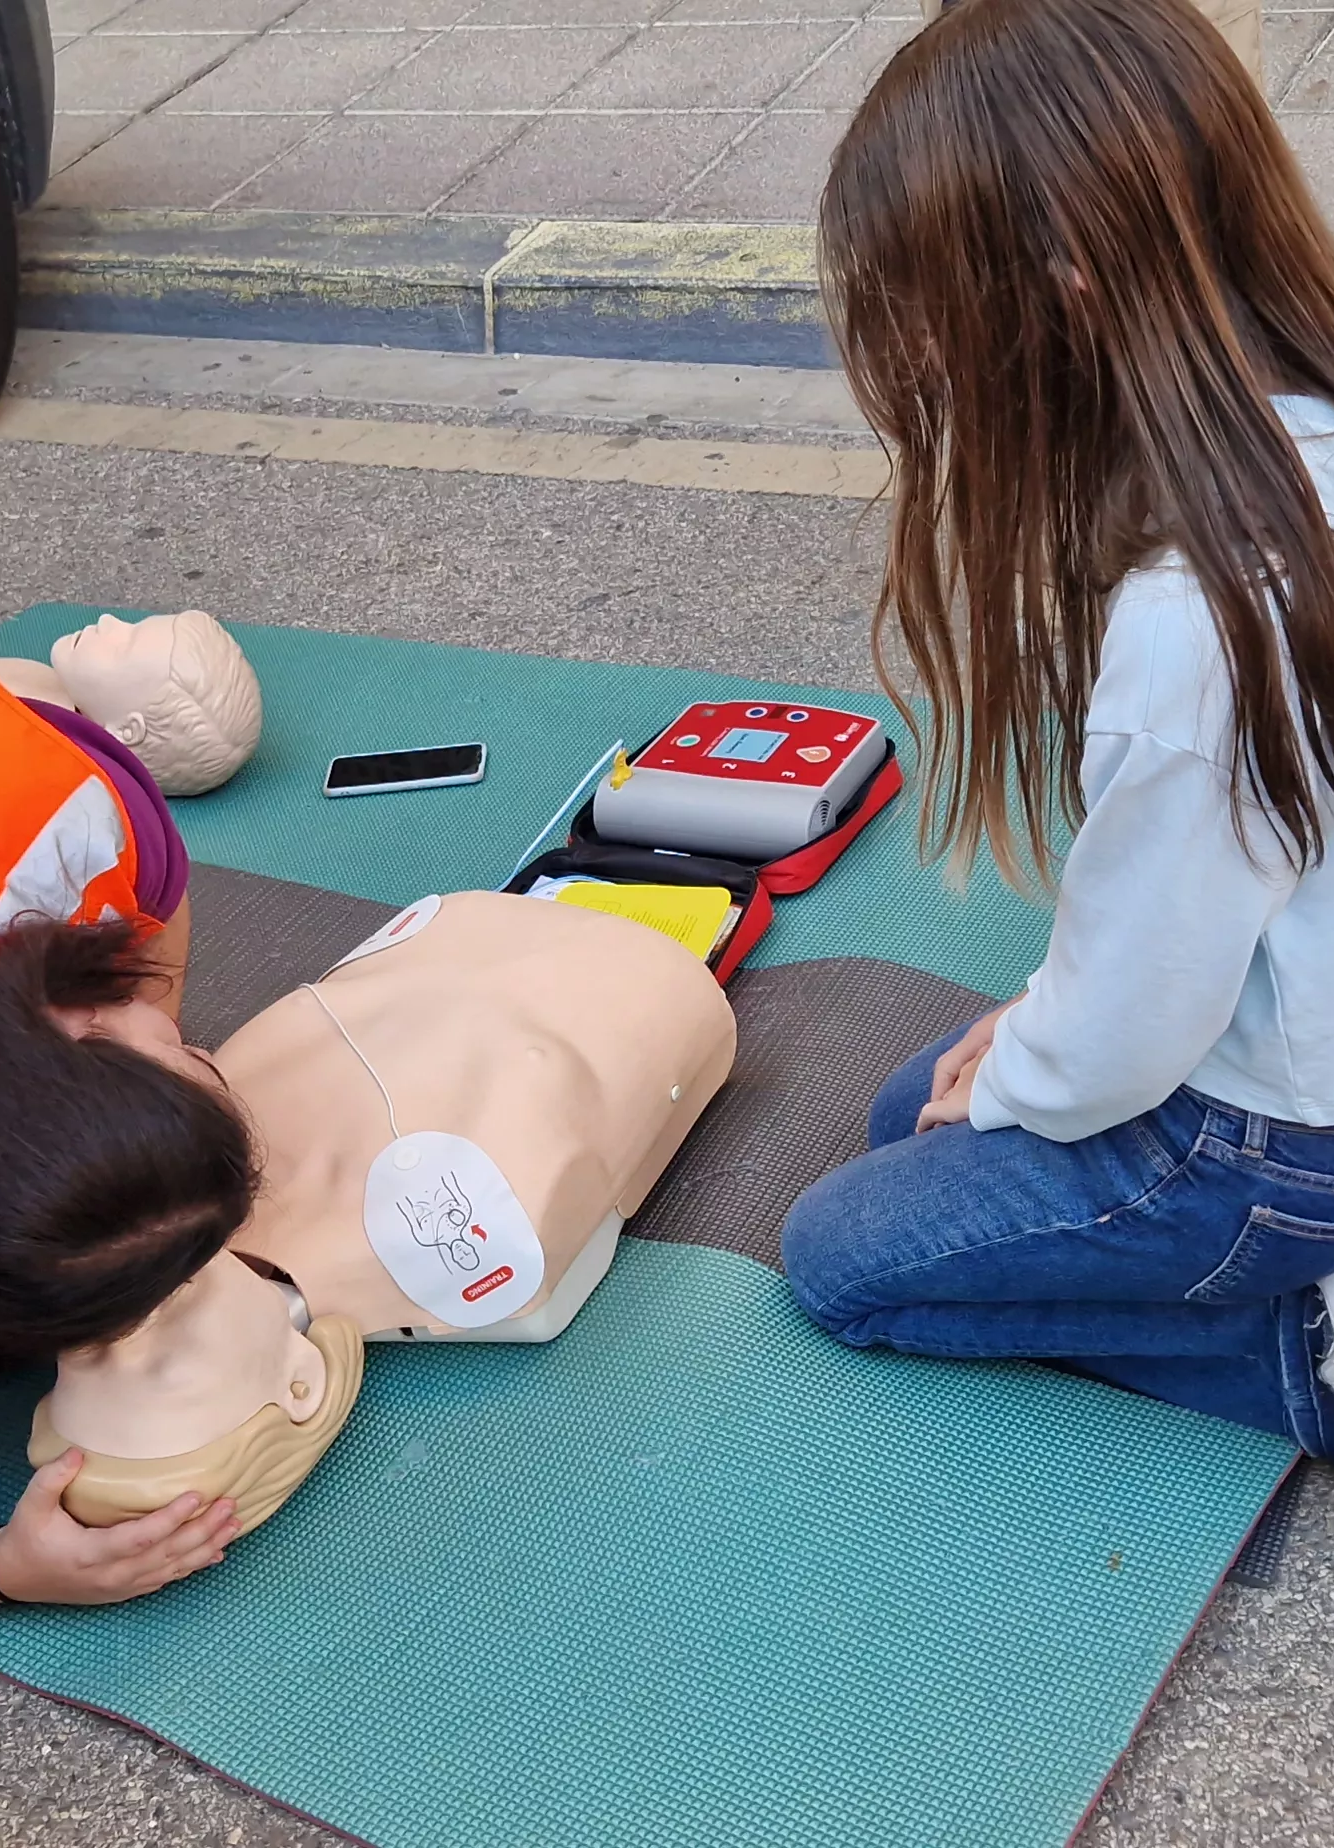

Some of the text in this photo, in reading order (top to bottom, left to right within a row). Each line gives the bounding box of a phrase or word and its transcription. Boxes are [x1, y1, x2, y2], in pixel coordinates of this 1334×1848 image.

[721, 762, 738, 770] 2
[780, 770, 796, 779] 3
[467, 1271, 509, 1298] TRAINING
